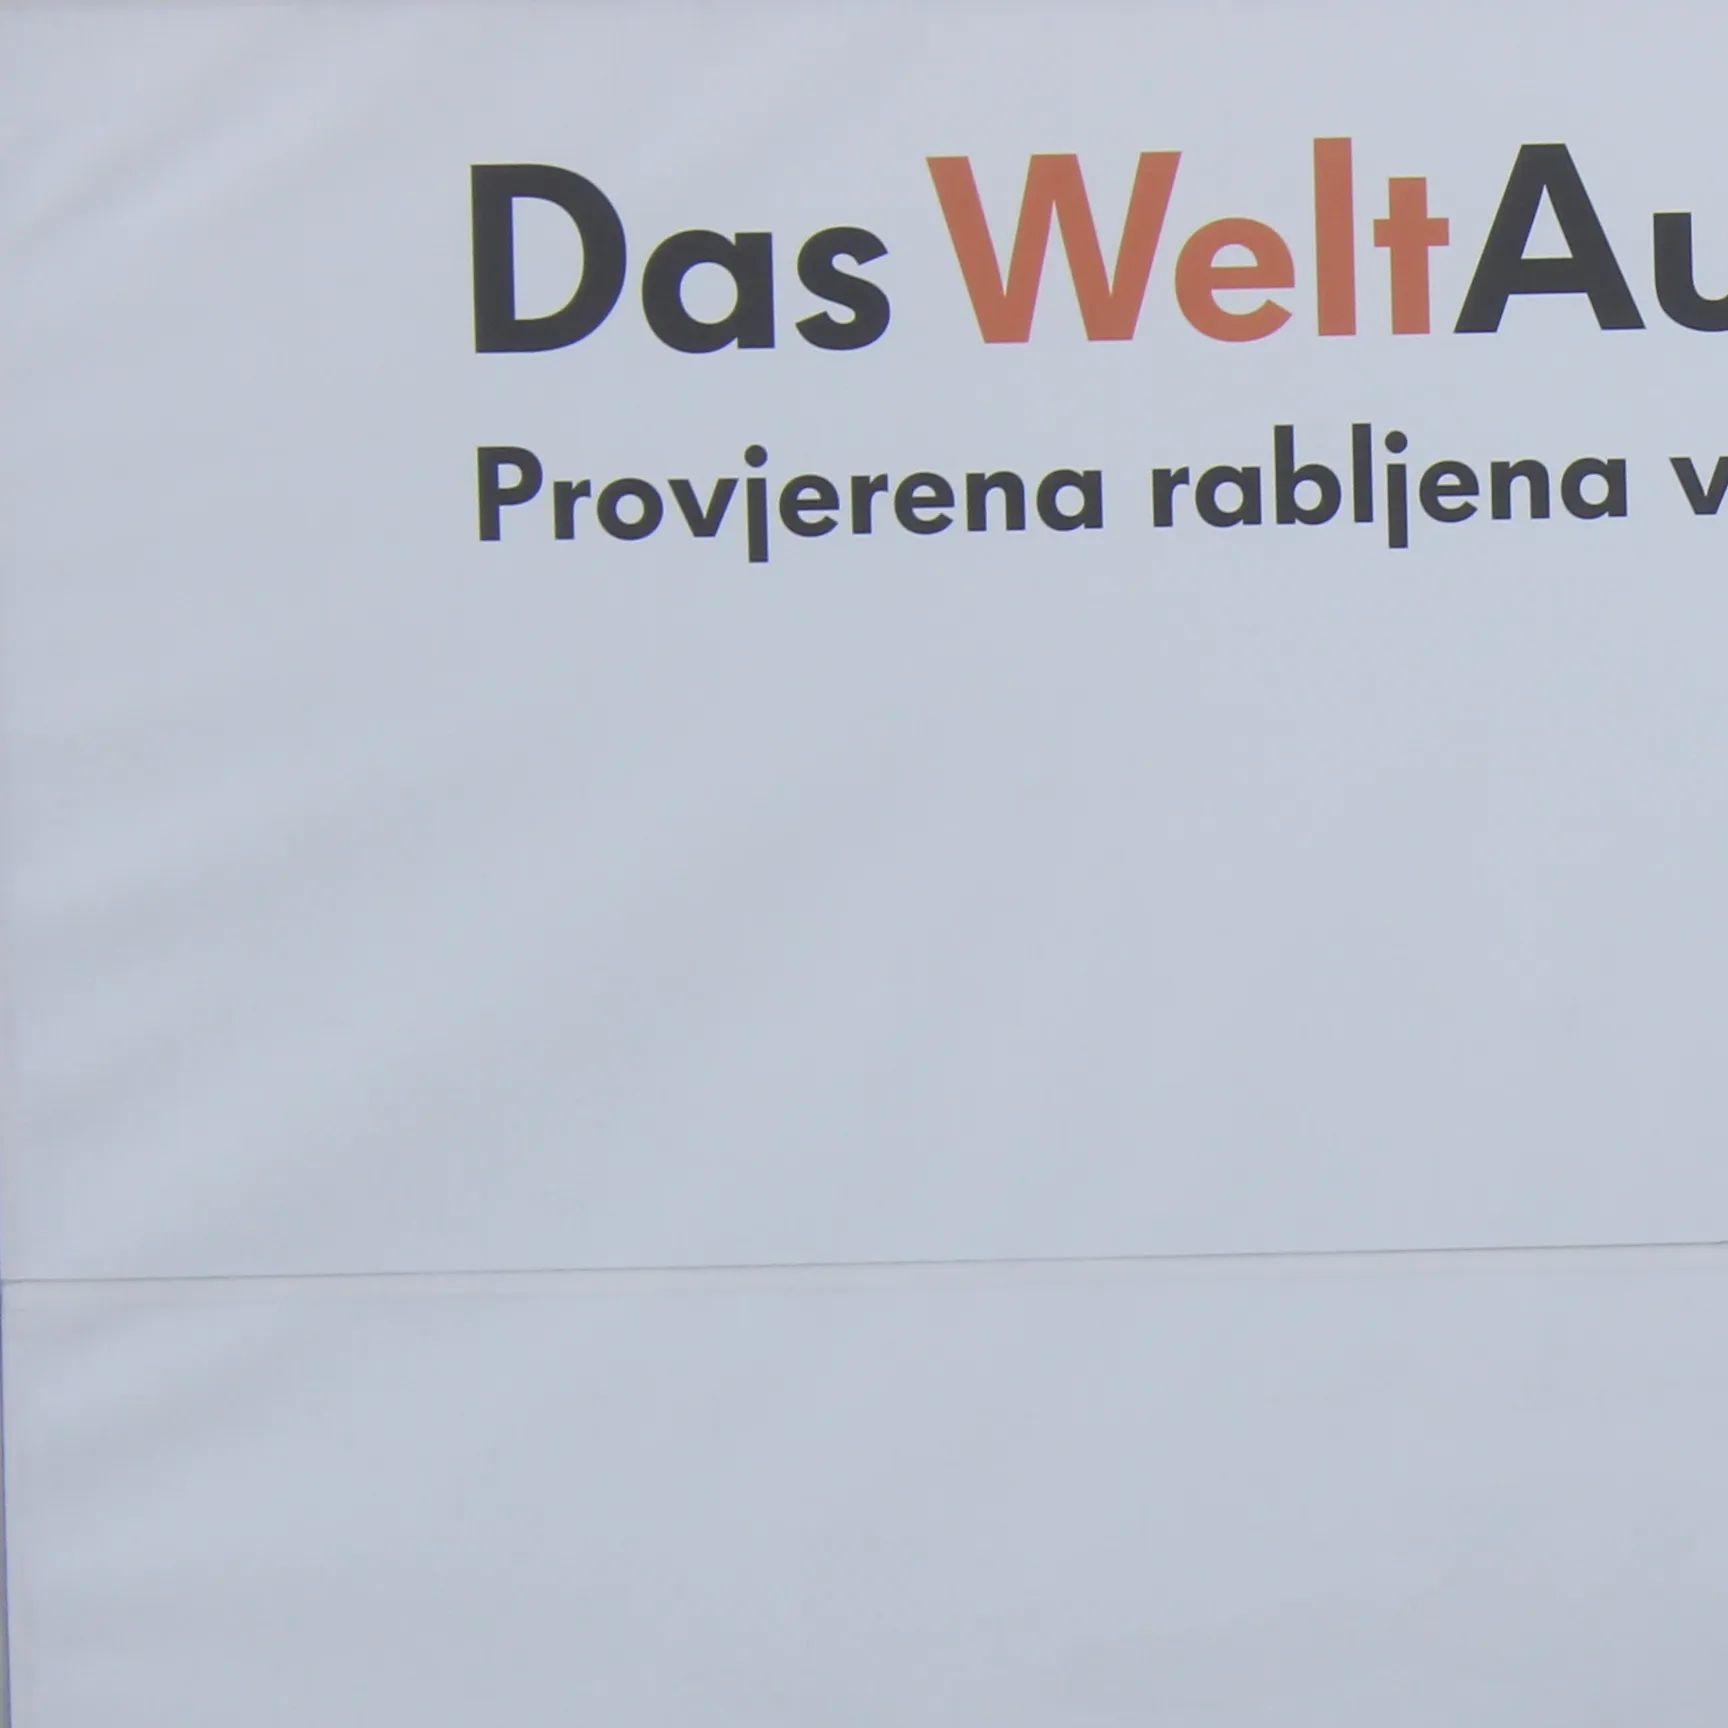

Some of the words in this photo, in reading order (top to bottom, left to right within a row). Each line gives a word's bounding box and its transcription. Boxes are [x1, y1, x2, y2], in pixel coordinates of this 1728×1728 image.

[469, 162, 891, 354] Das
[475, 444, 1104, 564] Provjerena
[1152, 423, 1628, 549] rabljena
